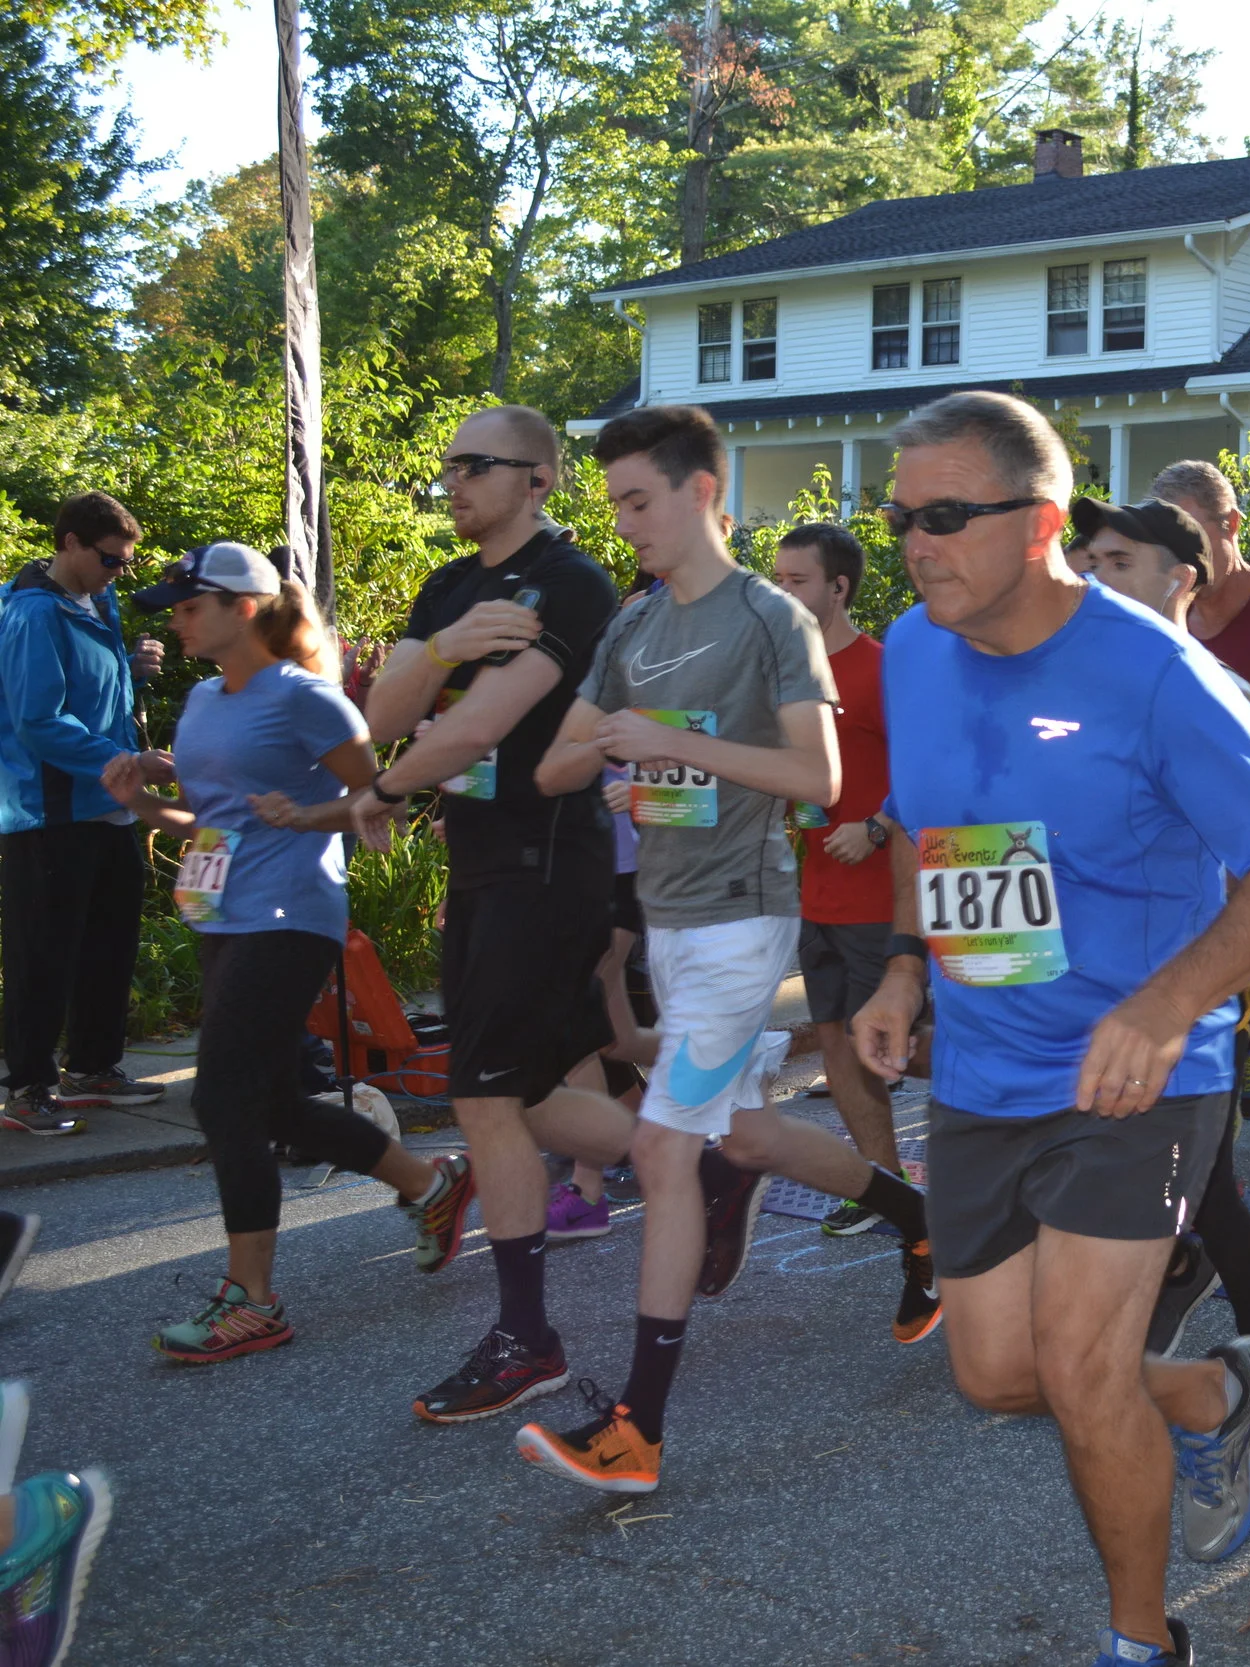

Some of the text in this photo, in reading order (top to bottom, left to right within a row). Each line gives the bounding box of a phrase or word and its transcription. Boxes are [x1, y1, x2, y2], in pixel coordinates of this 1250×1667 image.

[925, 835, 946, 850] We
[922, 849, 950, 868] Run
[954, 847, 998, 866] Events
[928, 867, 1052, 931] 1870
